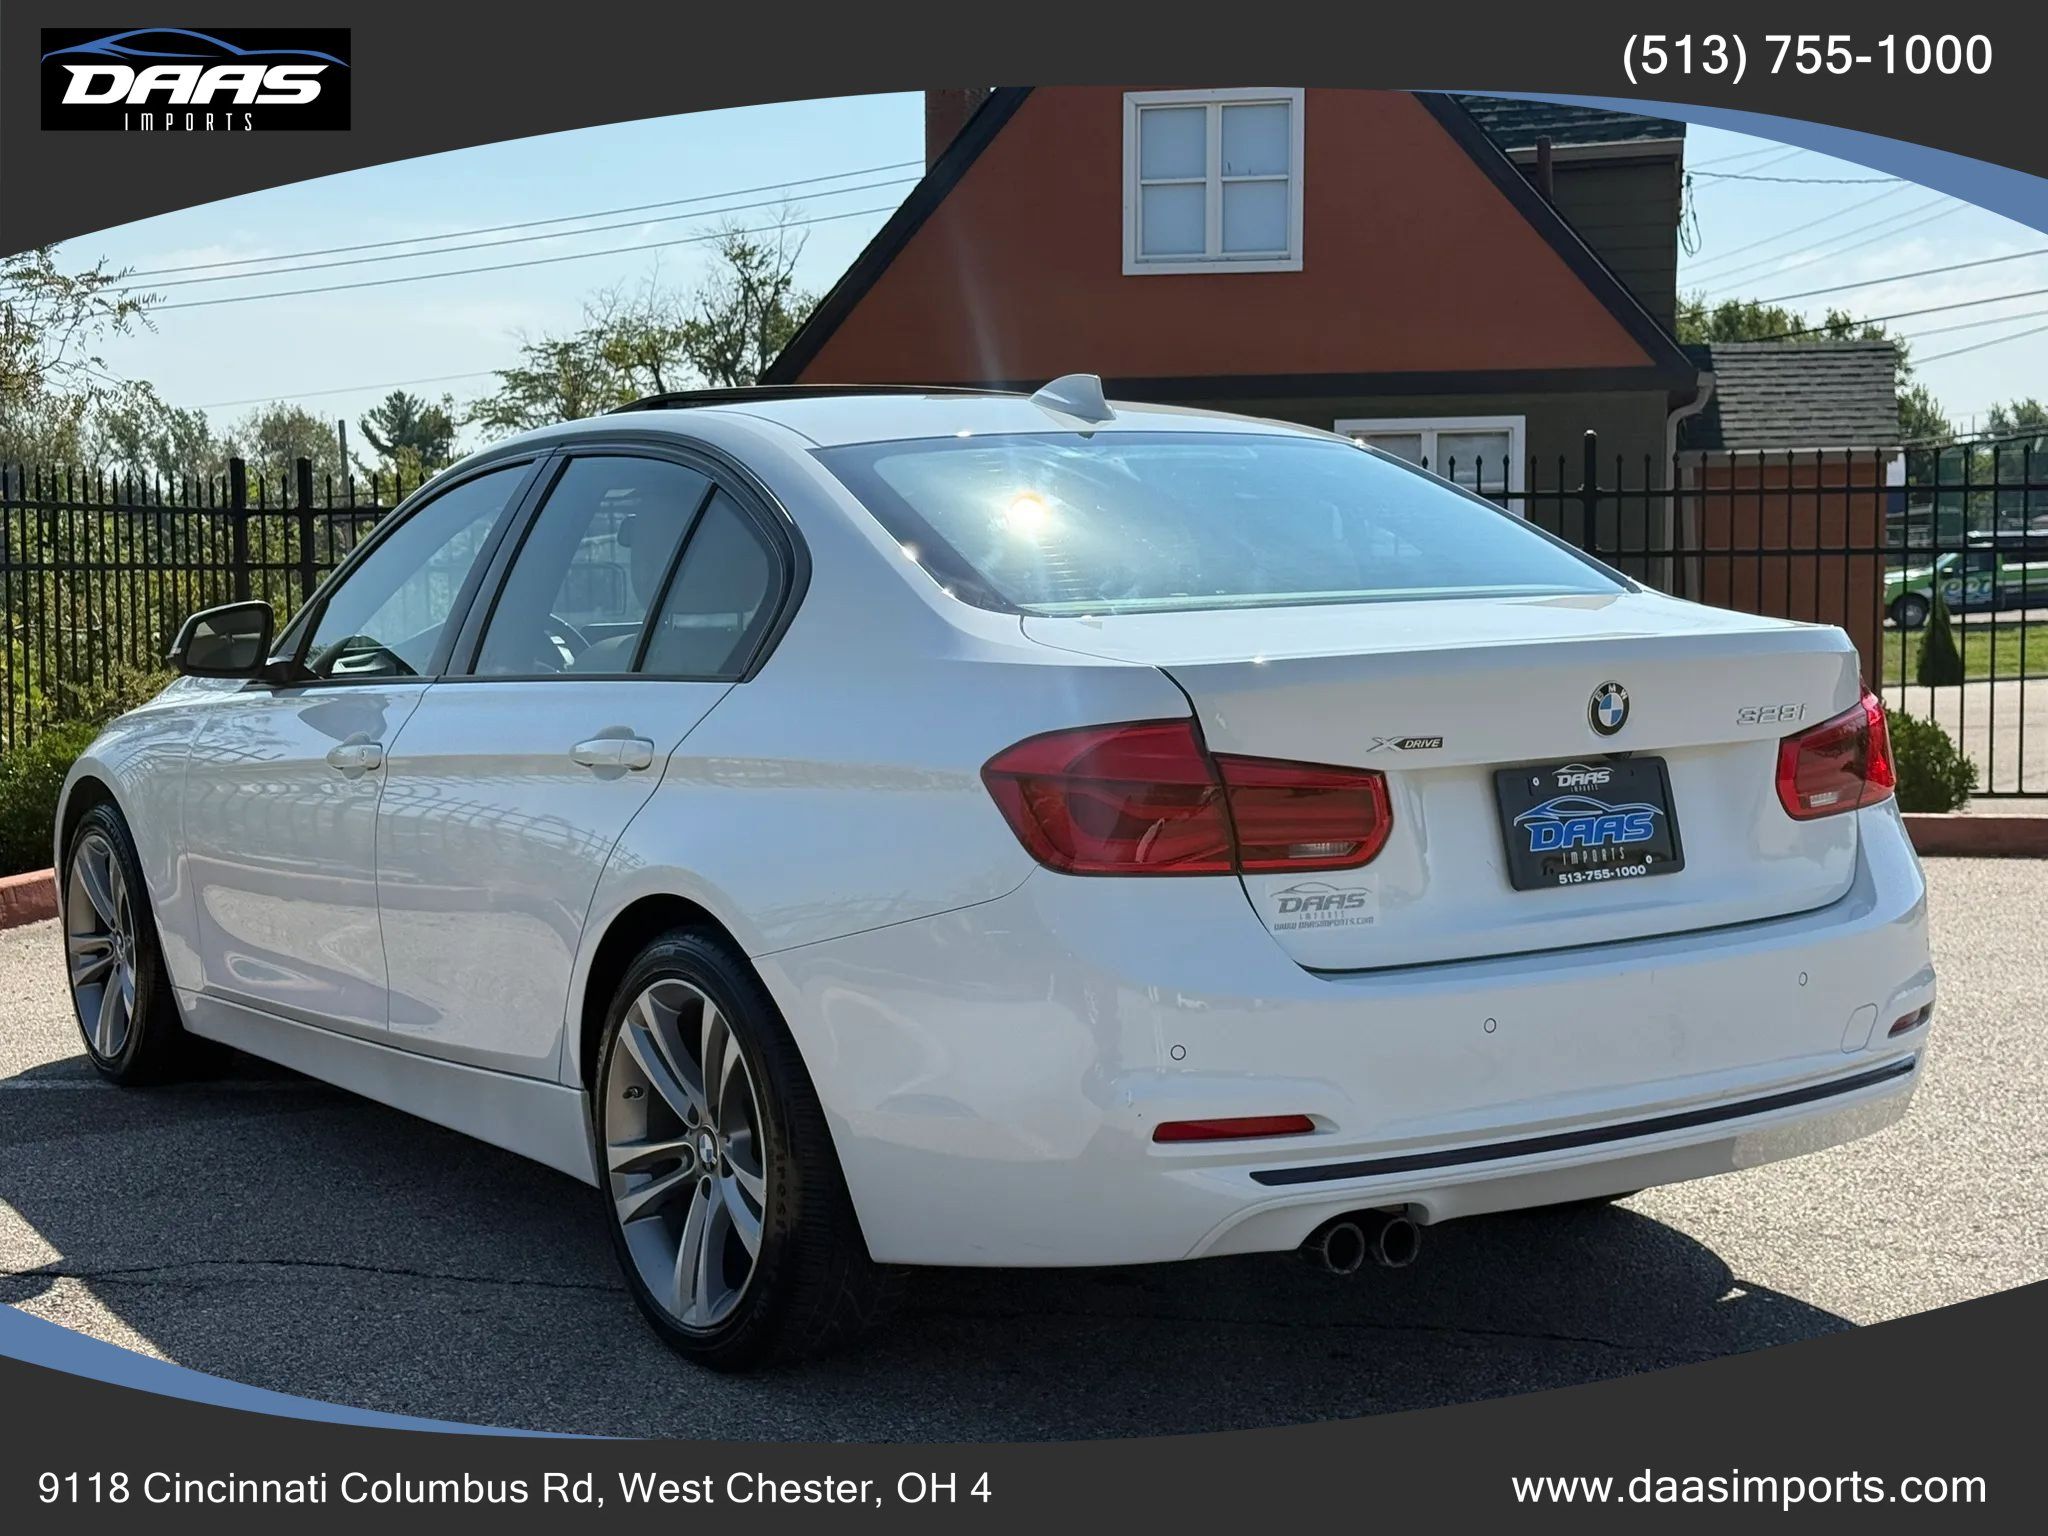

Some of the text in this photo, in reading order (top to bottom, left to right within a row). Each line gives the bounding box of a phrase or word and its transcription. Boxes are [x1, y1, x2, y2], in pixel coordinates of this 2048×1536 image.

[1736, 703, 1807, 726] 328i
[1557, 771, 1610, 787] DAAS
[1524, 811, 1655, 852] DAAS
[1562, 846, 1626, 866] IMPORTS
[1558, 864, 1647, 884] 513-755-1000
[1278, 893, 1367, 914] DAAS
